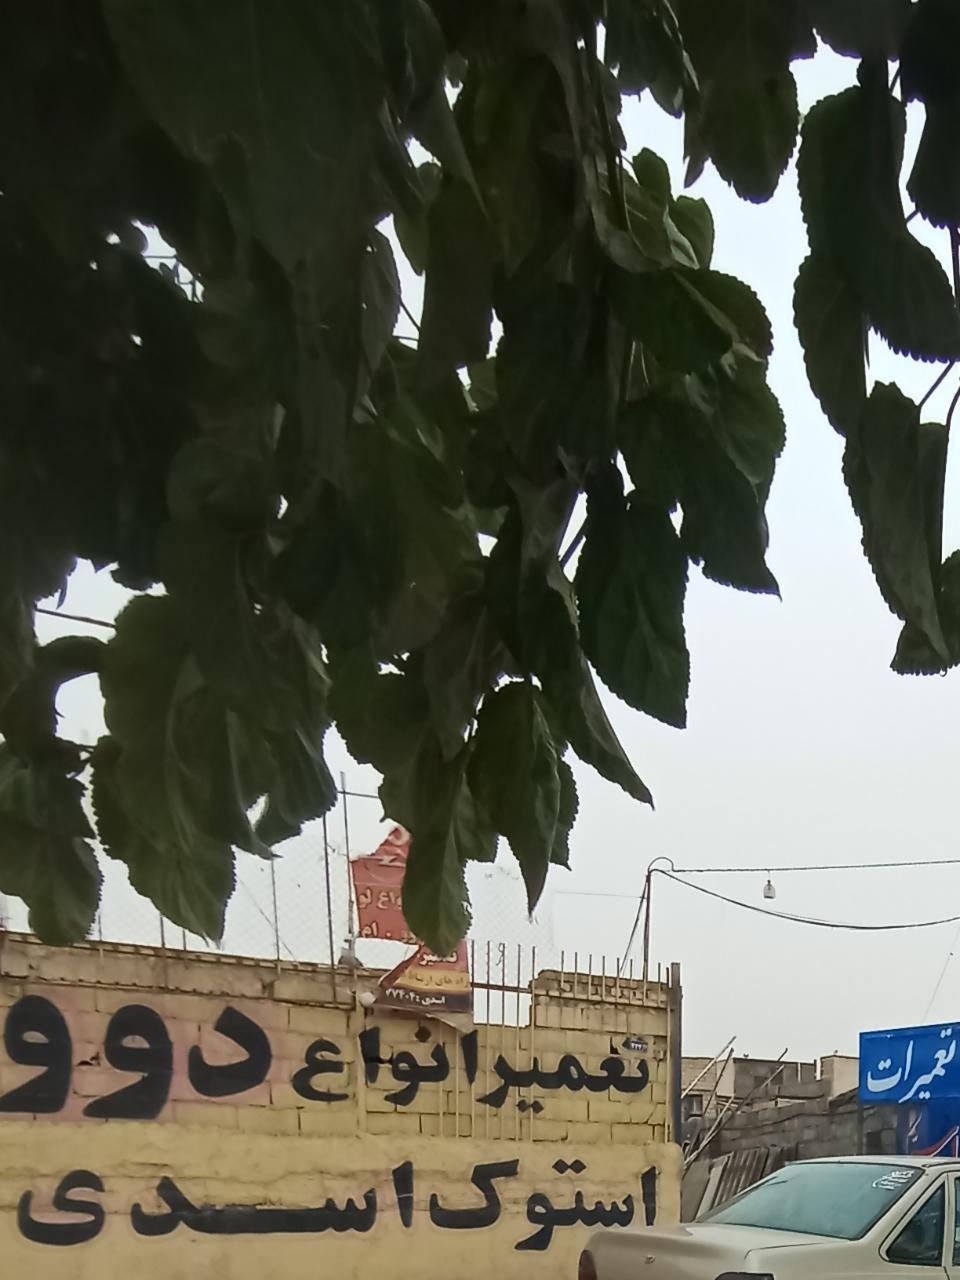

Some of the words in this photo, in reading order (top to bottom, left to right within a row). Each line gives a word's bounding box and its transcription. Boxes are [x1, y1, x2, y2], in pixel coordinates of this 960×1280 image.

[0, 994, 273, 1120] دوو
[291, 1025, 479, 1106] انواع
[867, 1028, 957, 1104] تعمیرات
[17, 1160, 415, 1246] اسدی
[428, 1158, 658, 1251] استوک
